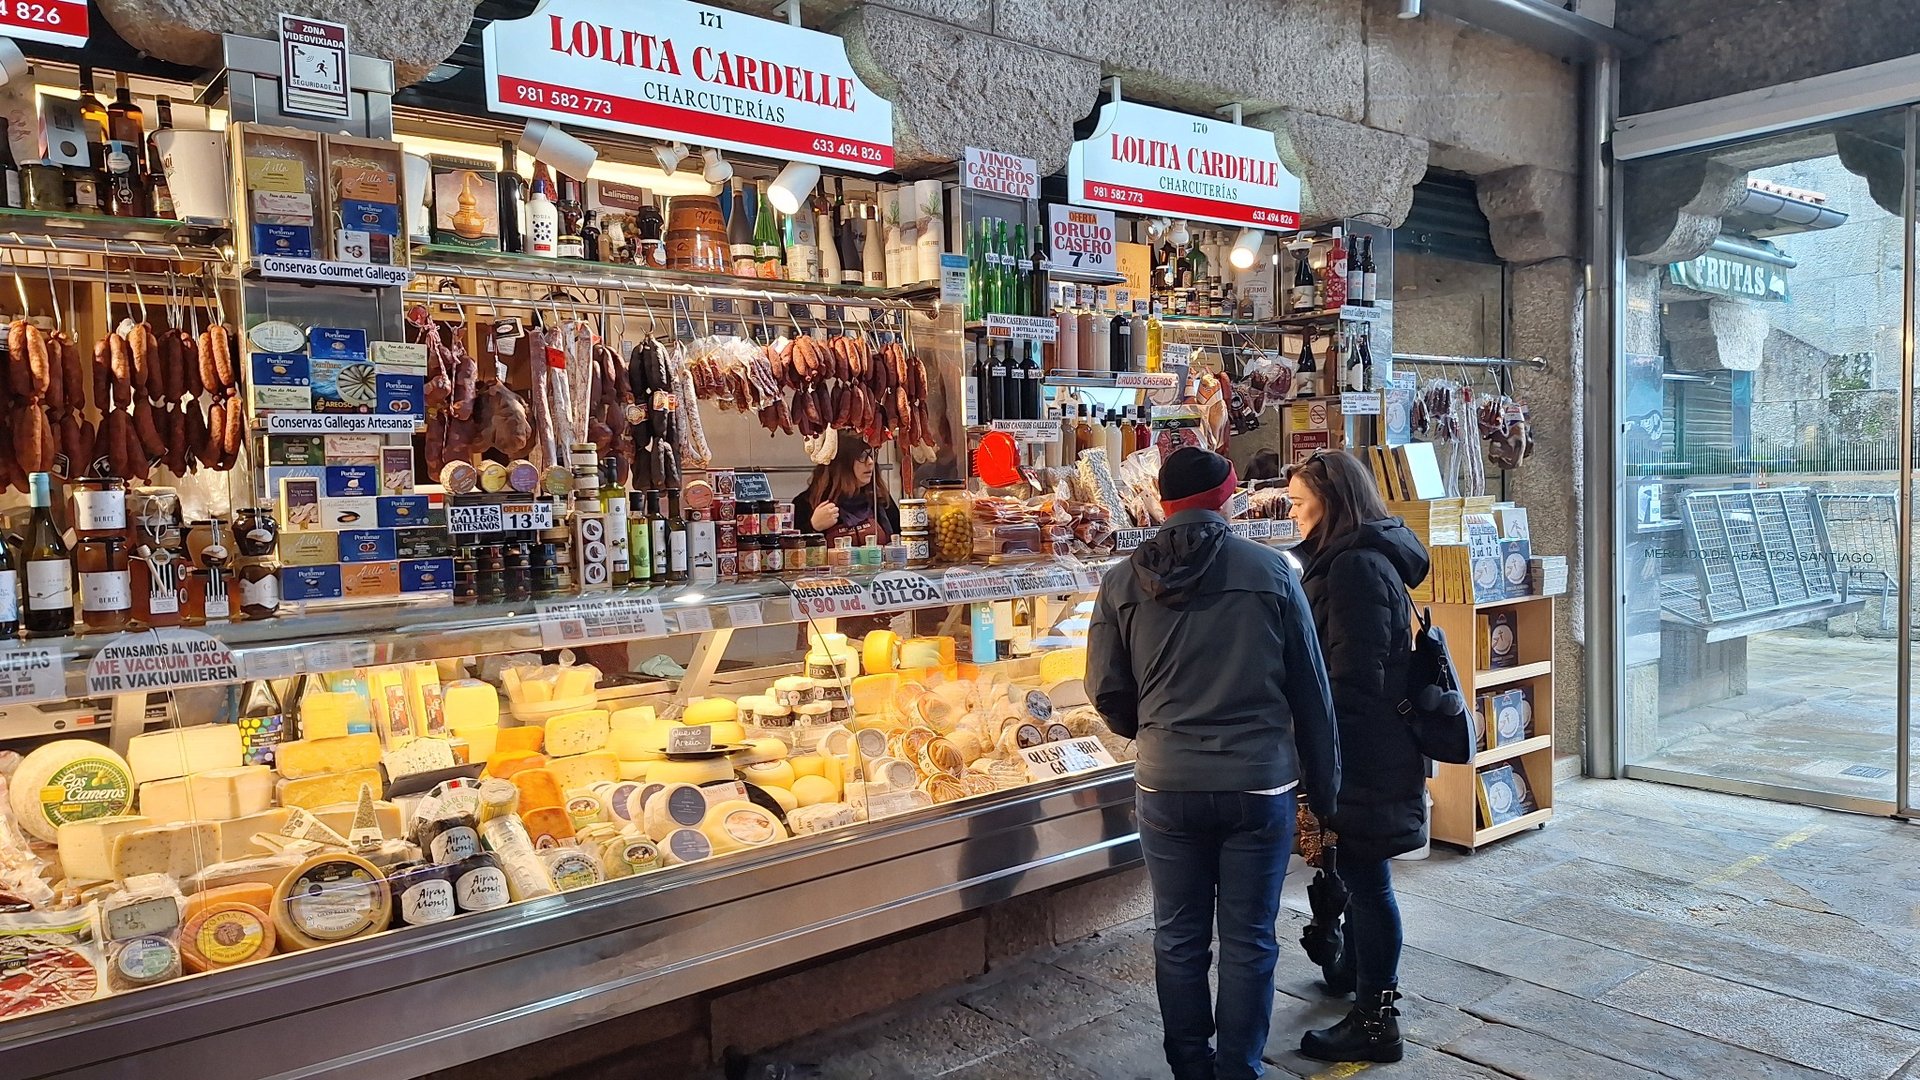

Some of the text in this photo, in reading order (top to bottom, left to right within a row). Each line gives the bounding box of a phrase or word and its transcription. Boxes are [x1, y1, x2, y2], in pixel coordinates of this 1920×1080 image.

[16, 1, 61, 25] 826
[699, 11, 723, 29] 171
[302, 24, 326, 36] ZONA
[283, 30, 345, 49] VIDEOVIXIADA
[548, 13, 856, 113] LOLITA CARDELLE
[292, 78, 332, 91] SEGURIDADE
[517, 85, 612, 116] 981 582 773
[644, 81, 785, 123] CHARCUTERÍAS
[1192, 122, 1208, 134] 170
[812, 138, 882, 161] 633 494 826
[979, 151, 1023, 171] VINOS
[1111, 133, 1279, 187] LOLITA CARDELLE
[967, 162, 1035, 185] CASEROS
[602, 187, 640, 202] Lalinense
[973, 175, 1031, 198] GALICIA
[1093, 185, 1144, 203] 981 582 773
[1159, 175, 1238, 200] CHARCUTERÍAS
[1068, 211, 1098, 224] OFERTA
[1252, 210, 1293, 225] 633 494 826
[1054, 220, 1112, 241] ORUJO
[1054, 237, 1112, 255] CASERO
[264, 258, 406, 284] Conservas Gourmet Gallegas
[1694, 255, 1766, 296] FRUTAS
[990, 315, 1055, 328] VINOS CASEROS GALLEGOS
[1118, 376, 1173, 386] ORUJOS CASEROS
[271, 415, 412, 431] Conservas Gallegas Artesanas
[994, 420, 1058, 429] VINOS CASEROS GALLEGOS
[450, 507, 499, 516] PATES
[503, 505, 552, 513] OFERTA 3 ud.
[450, 515, 500, 524] GALLEGOS
[450, 522, 500, 532] ARTESANOS
[1118, 530, 1142, 540] ALUBIA
[1644, 548, 1875, 563] MERCADO DE ABASTOS SANTIAGO
[872, 576, 929, 593] ARZUA
[946, 576, 1006, 589] WE VACUUM PACK
[792, 584, 862, 600] QUESO CASERO
[872, 587, 941, 606] ULLOA
[946, 586, 1012, 600] WIR VAKUUMIEREN
[841, 595, 866, 611] ud.
[104, 640, 217, 659] ENVASAMOS AL VACIO
[95, 651, 233, 675] WE VACUUM PACK
[91, 665, 238, 691] WIR VAKUUMIEREN
[672, 729, 702, 738] Queixo
[1028, 746, 1066, 764] QUESO
[58, 773, 88, 788] Los
[66, 783, 127, 801] Cameros
